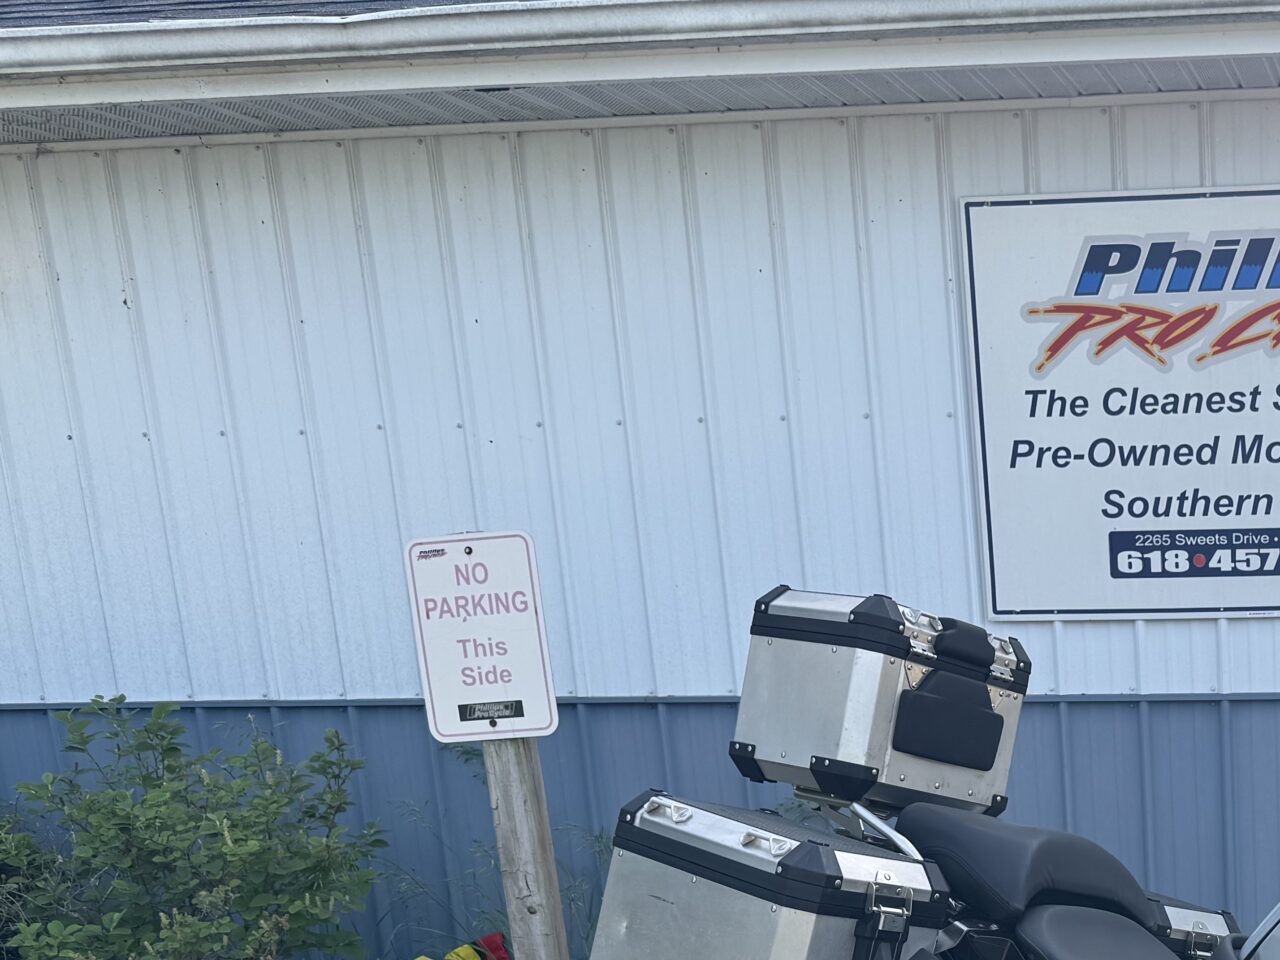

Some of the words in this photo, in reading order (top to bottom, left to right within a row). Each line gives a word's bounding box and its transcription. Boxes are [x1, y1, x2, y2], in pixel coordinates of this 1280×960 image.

[1027, 303, 1221, 372] PRO
[1024, 389, 1089, 418] The
[1102, 384, 1262, 416] Cleanest
[1009, 435, 1221, 469] Pre-Owned
[1101, 486, 1274, 519] Southern
[1135, 534, 1171, 546] 2265
[1175, 532, 1228, 546] Sweets
[1232, 531, 1270, 545] Drive
[454, 562, 489, 587] NO
[424, 590, 529, 620] PARKING
[457, 637, 508, 660] This
[461, 664, 513, 688] Side
